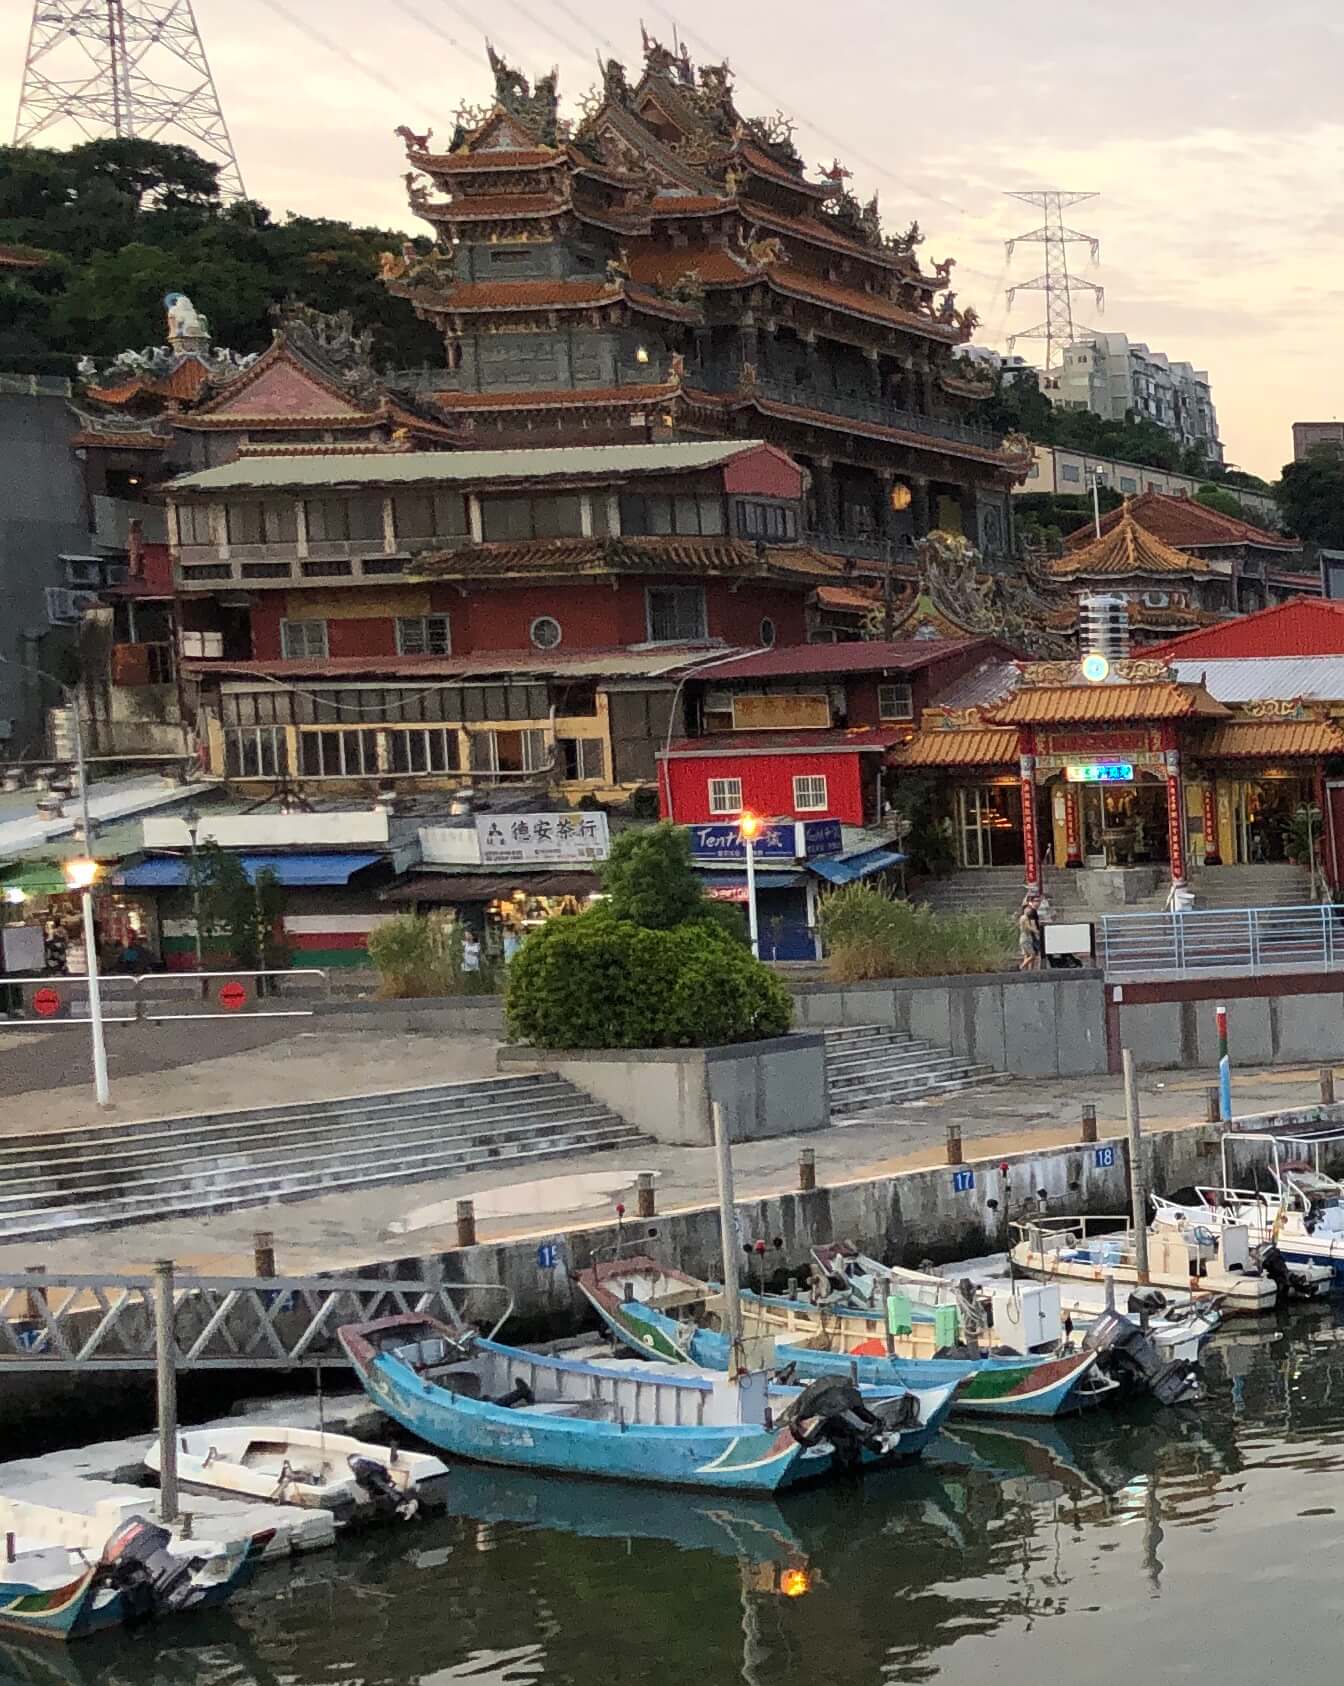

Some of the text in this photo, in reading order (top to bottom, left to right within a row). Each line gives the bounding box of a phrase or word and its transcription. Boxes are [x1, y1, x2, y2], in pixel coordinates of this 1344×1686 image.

[510, 819, 598, 841] 德安茶行
[1097, 1150, 1113, 1167] 18
[955, 1172, 972, 1191] 17
